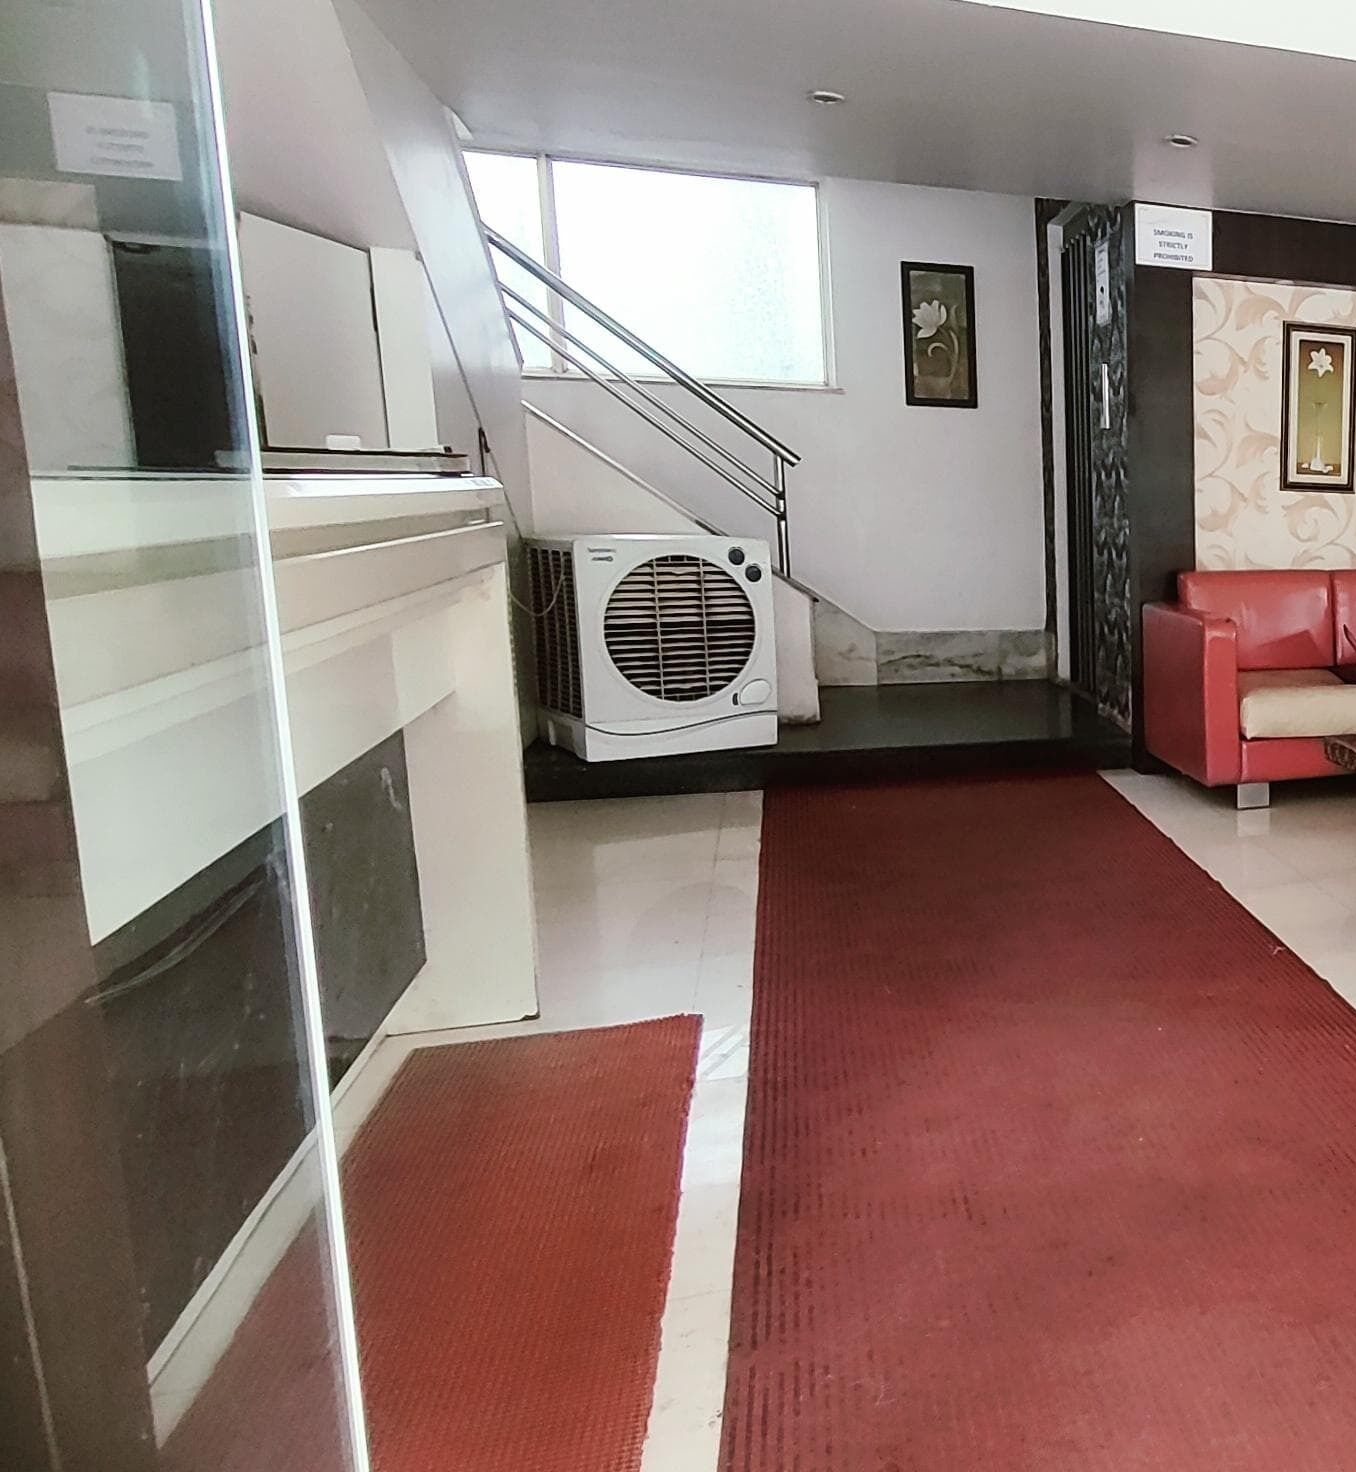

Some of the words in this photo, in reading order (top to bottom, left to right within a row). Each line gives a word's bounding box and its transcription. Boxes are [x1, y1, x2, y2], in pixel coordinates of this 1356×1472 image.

[1153, 228, 1186, 239] SMOKING
[1187, 232, 1194, 240] IS
[1158, 240, 1189, 251] STRICTLY
[1153, 252, 1194, 263] PROHIBITED
